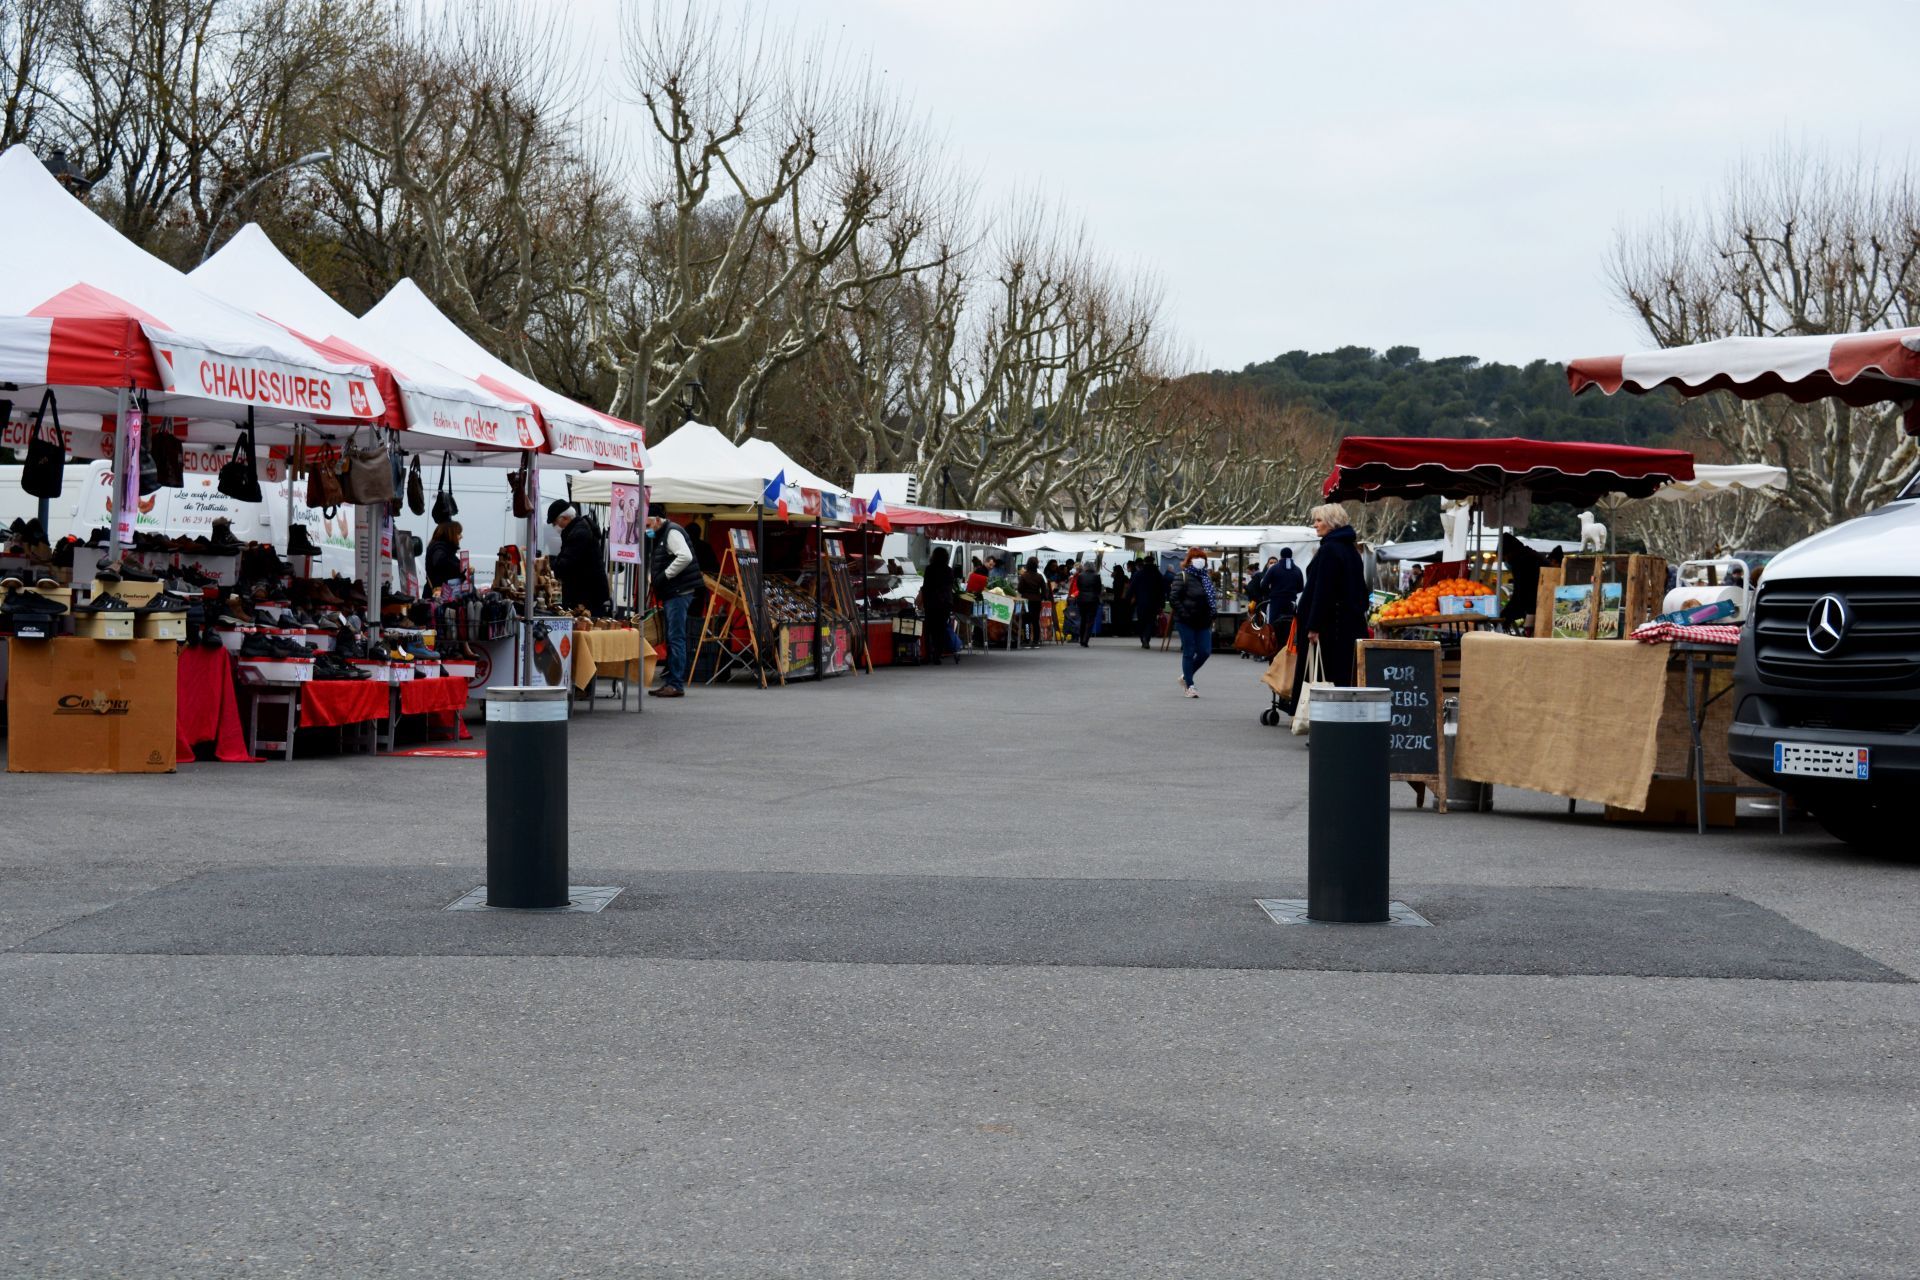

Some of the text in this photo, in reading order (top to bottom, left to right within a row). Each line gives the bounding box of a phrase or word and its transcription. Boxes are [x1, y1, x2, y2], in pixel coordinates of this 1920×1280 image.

[200, 360, 332, 411] CHAUSSURES
[195, 502, 228, 511] Nathalie
[1383, 666, 1415, 681] PUR
[1390, 714, 1412, 727] DU
[1858, 764, 1867, 776] 12
